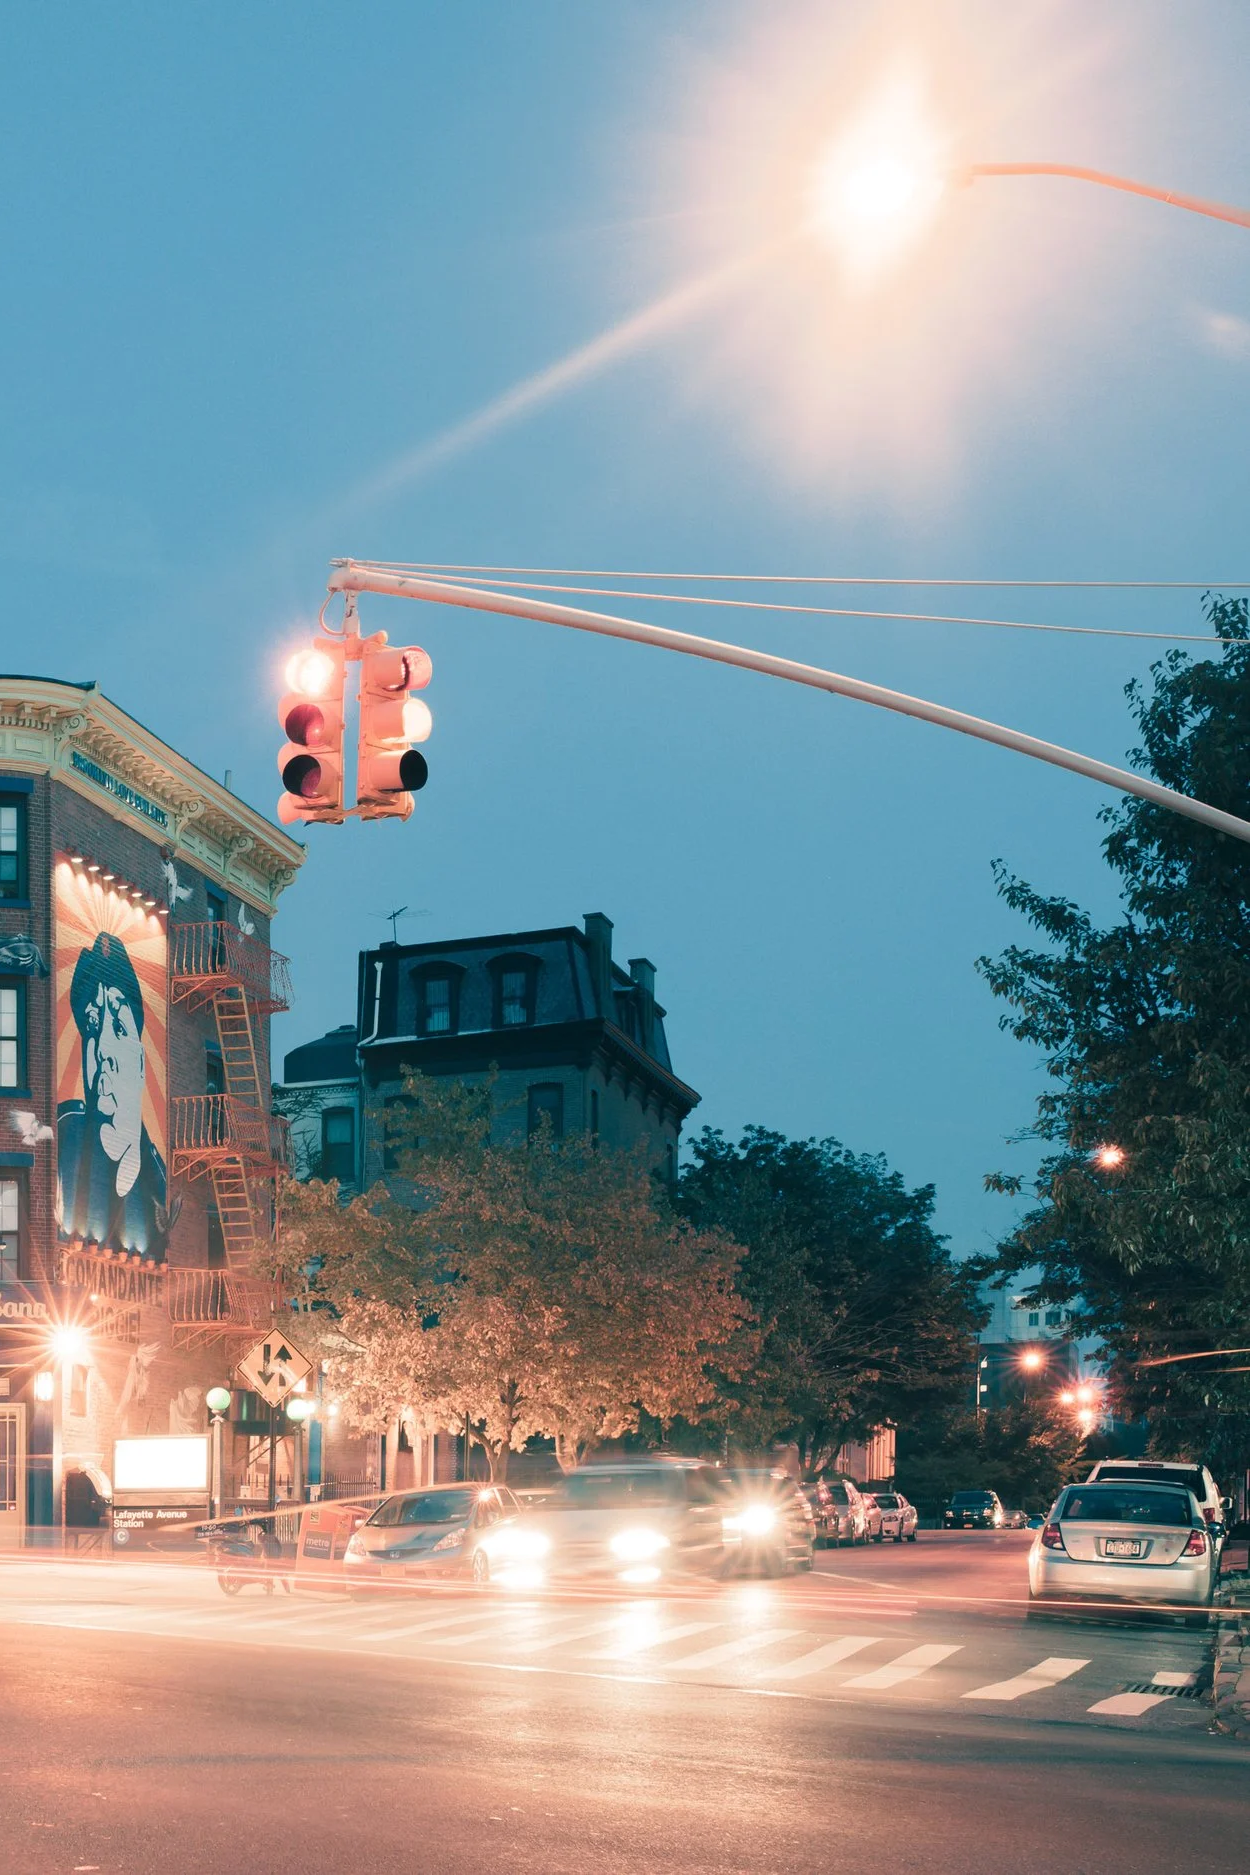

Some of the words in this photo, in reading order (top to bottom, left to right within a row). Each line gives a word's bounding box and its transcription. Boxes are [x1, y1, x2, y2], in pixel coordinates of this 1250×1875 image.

[66, 1253, 163, 1306] COMANDANTE
[113, 1510, 153, 1520] Lafayette
[156, 1510, 187, 1518] Avenue
[113, 1520, 144, 1528] Station
[116, 1531, 126, 1541] C
[306, 1537, 330, 1548] metro
